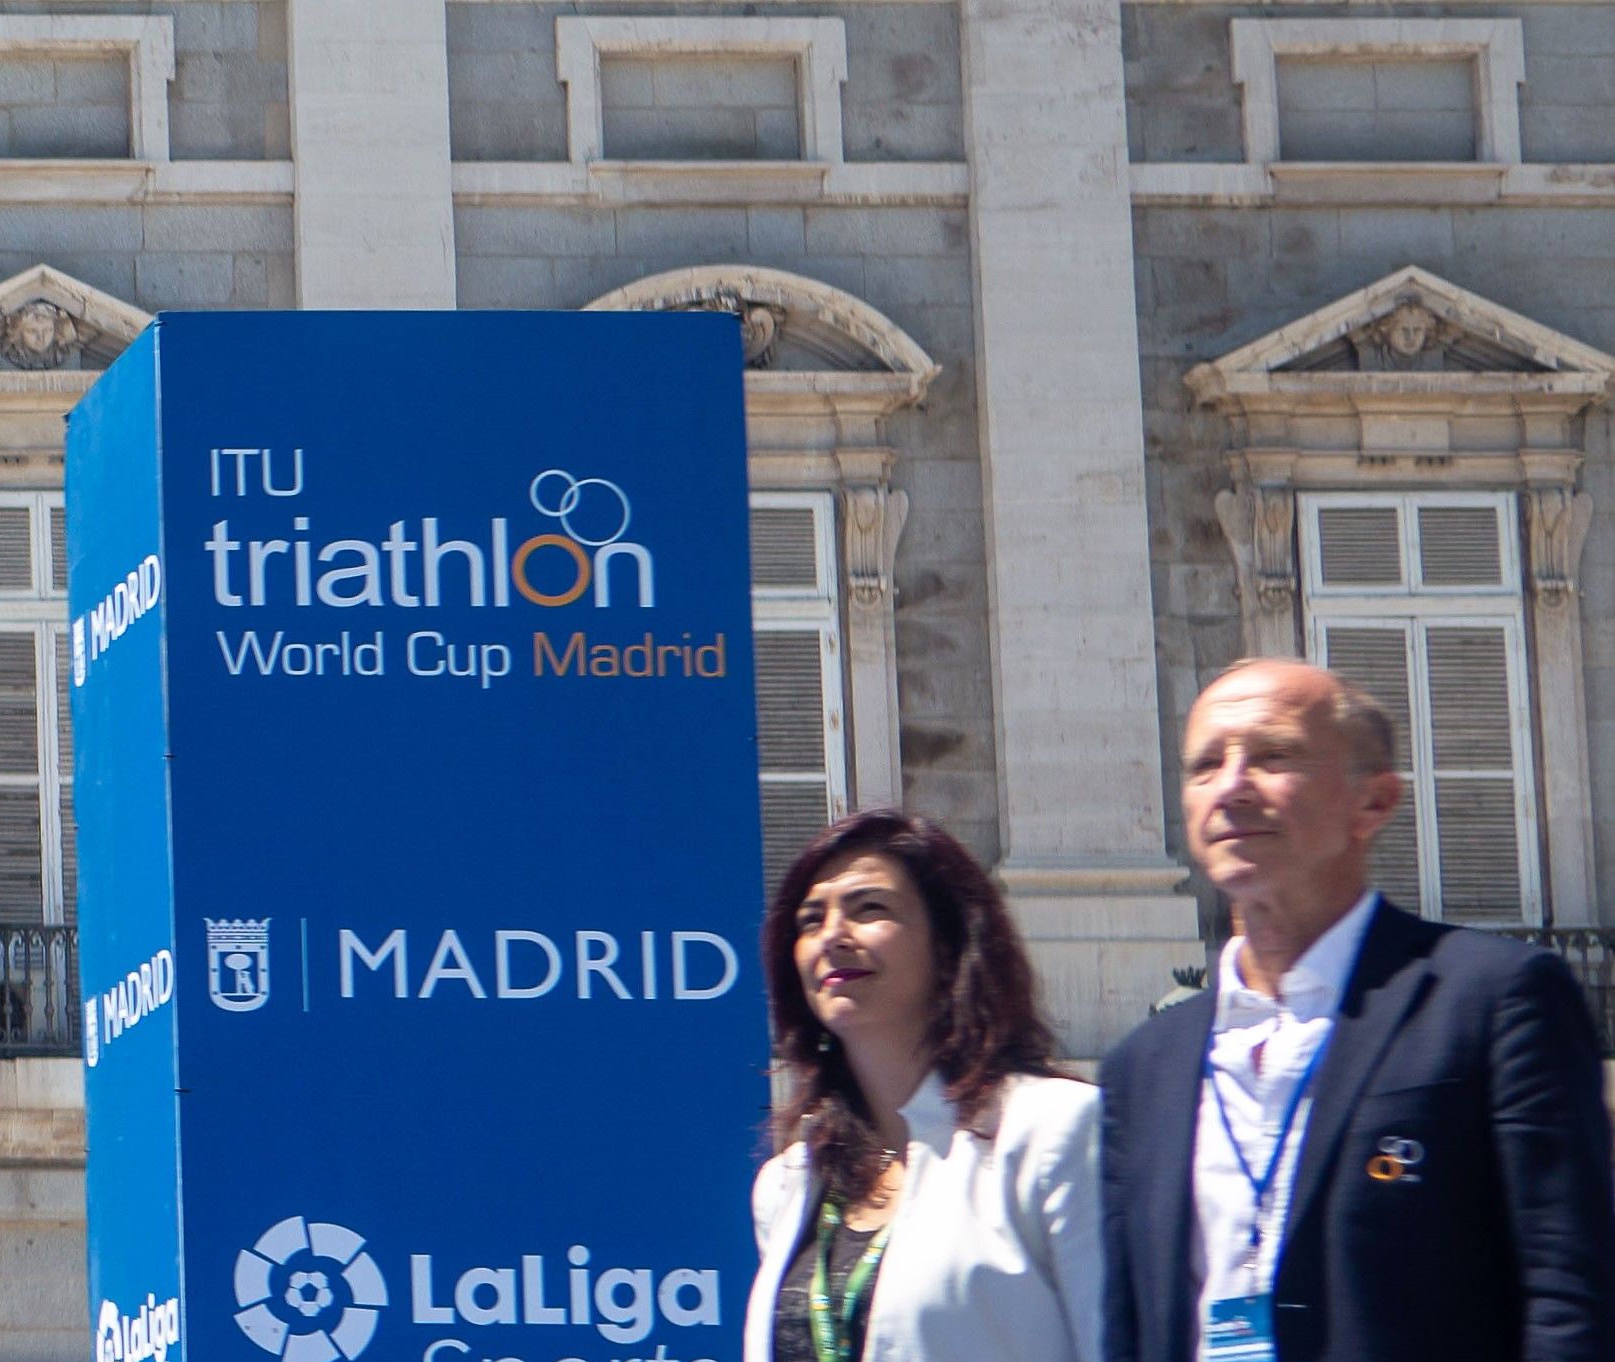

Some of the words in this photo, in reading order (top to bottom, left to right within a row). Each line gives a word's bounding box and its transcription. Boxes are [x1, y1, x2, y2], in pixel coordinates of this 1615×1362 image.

[209, 448, 304, 497] ITU
[91, 554, 161, 661] MADRID
[204, 516, 655, 609] triathlon
[215, 630, 384, 677] World
[406, 630, 512, 690] Cup
[533, 631, 727, 679] Madrid
[102, 948, 174, 1045] MADRID
[339, 928, 739, 1001] MADRID
[410, 1244, 721, 1345] LaLiga
